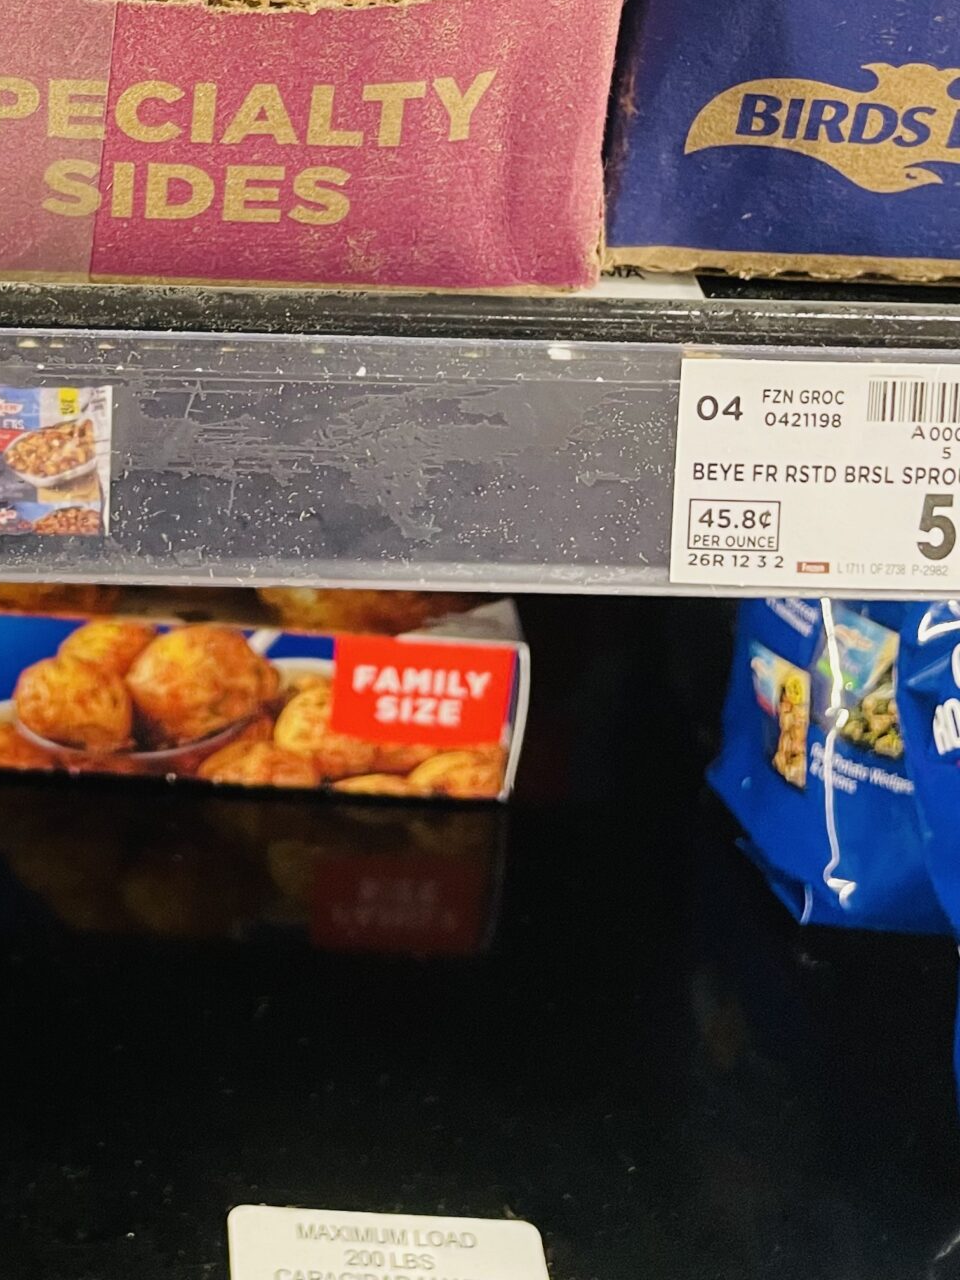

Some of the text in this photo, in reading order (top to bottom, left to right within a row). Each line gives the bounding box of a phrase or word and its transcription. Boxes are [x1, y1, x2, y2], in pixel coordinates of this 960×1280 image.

[734, 92, 938, 148] BIRDS
[41, 157, 353, 226] SIDES
[696, 389, 846, 421] 04 FZN GROC
[764, 412, 843, 429] 0421198
[692, 462, 895, 485] BEYE FR RSTD BRSL
[698, 508, 773, 531] 45.8¢
[916, 493, 958, 562] 5
[692, 534, 776, 549] PER OUNCE
[688, 553, 725, 568] 26R
[731, 554, 750, 569] 12
[756, 555, 768, 569] 3
[773, 556, 785, 569] 2
[351, 663, 492, 700] FAMILY
[374, 694, 464, 728] SIZE
[296, 1222, 477, 1249] MAXIMUM LOAD
[344, 1248, 436, 1271] 200 LBS
